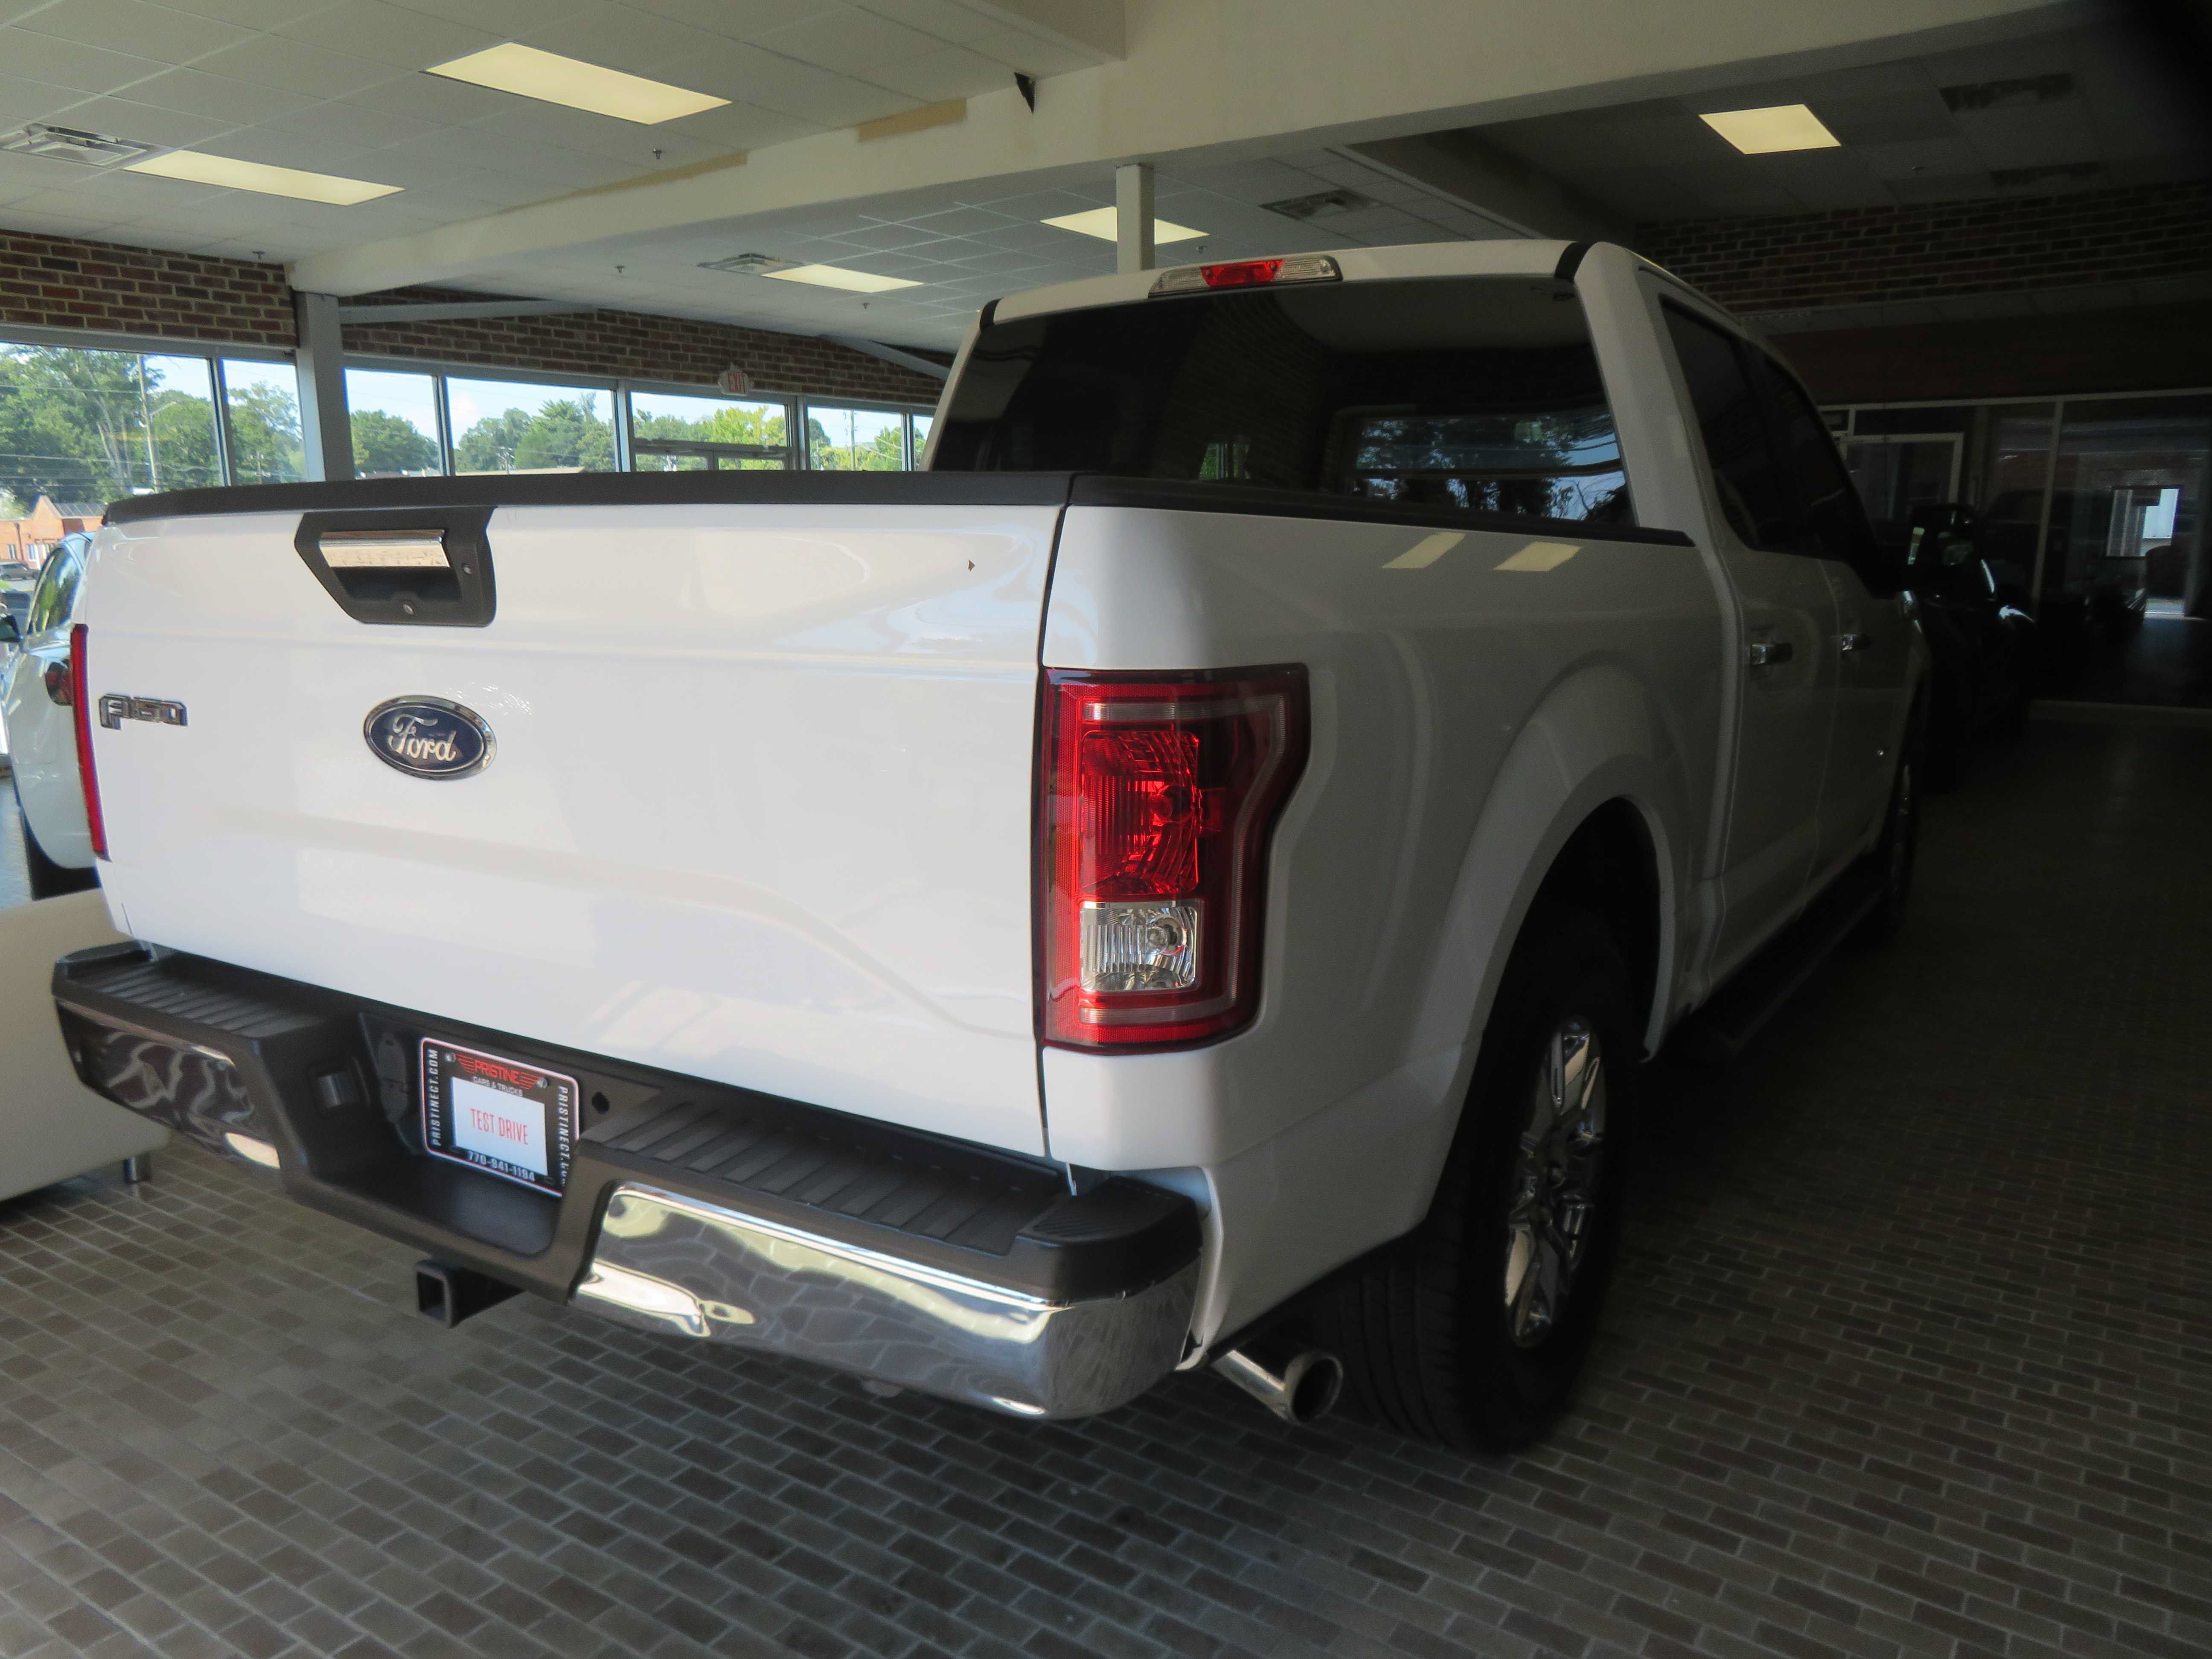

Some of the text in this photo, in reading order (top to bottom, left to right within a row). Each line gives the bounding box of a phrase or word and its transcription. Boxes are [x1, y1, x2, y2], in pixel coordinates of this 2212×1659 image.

[727, 373, 745, 393] EXIT
[387, 713, 457, 763] Ford
[472, 1076, 490, 1087] CARS
[497, 1083, 523, 1097] TRUCKS
[474, 1060, 520, 1085] PRISTINE
[427, 1048, 442, 1147] PRISTINECT.COM
[470, 1108, 529, 1145] TEST DRIVE
